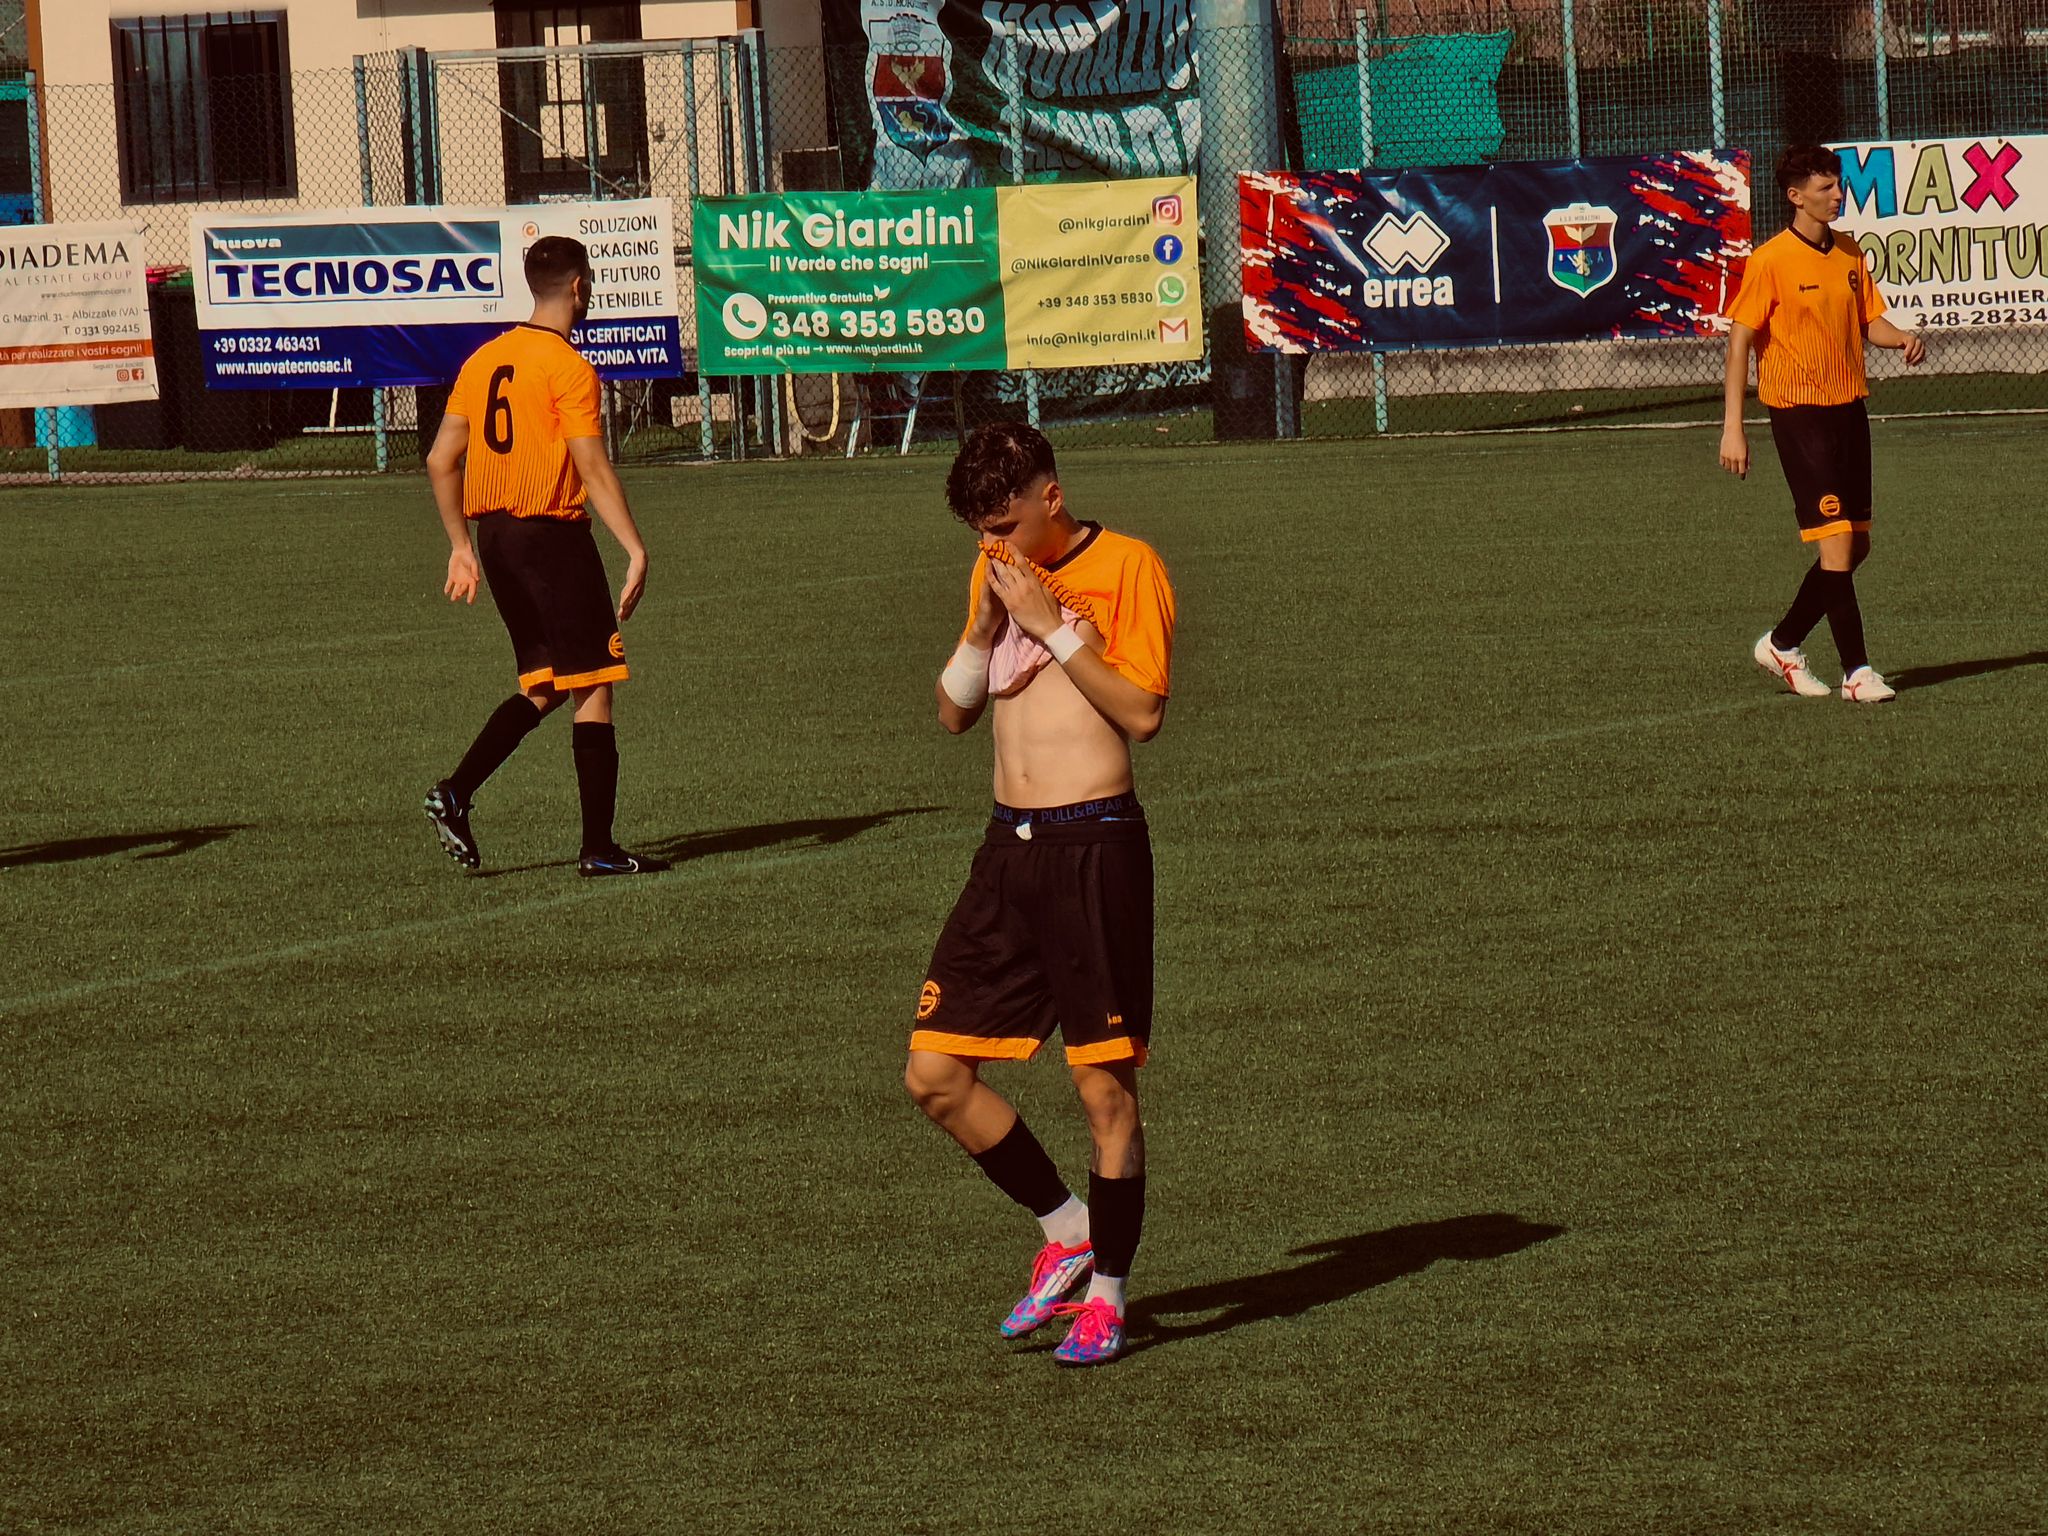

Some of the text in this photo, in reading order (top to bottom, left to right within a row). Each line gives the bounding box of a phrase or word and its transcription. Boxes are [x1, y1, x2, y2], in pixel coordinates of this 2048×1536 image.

[1833, 141, 2023, 219] MAX
[579, 215, 657, 235] SOLUZIONI
[719, 205, 974, 249] Nik Giardini
[1058, 213, 1150, 234] @nikgiardini
[212, 237, 282, 250] nuova
[786, 255, 836, 272] Verde
[841, 254, 874, 270] che
[879, 252, 929, 274] Sogni
[1011, 252, 1150, 273] @NikGiardiniVarese
[1845, 223, 2048, 286] ORNITU
[27, 273, 73, 286] ESTATE
[82, 270, 132, 282] GROUP
[215, 258, 495, 298] TECNOSAC
[601, 265, 661, 283] FUTURO
[482, 302, 498, 313] srl
[768, 291, 874, 305] Preventivo Gratuito
[1038, 292, 1153, 308] +39 348 353 5830
[1887, 290, 2048, 309] VIA BRUGHIER
[72, 308, 117, 320] Albizzate
[119, 306, 140, 317] (VA)
[772, 306, 985, 339] 348 353 5830
[74, 326, 100, 336] 0331
[102, 323, 140, 335] 992415
[587, 325, 666, 344] CERTIFICATI
[1027, 329, 1156, 348] info@nikgiardini.it
[11, 350, 26, 363] per
[28, 347, 74, 361] realizzare
[82, 344, 110, 356] vostri
[213, 336, 321, 353] +39 0332 463431
[724, 342, 923, 359] Scopri di più su www.nikgiardini.it
[637, 347, 669, 364] VITA
[216, 356, 353, 375] www.nuovatecnosac.it
[483, 364, 515, 455] 6
[1041, 799, 1123, 823] PULL&BEAR
